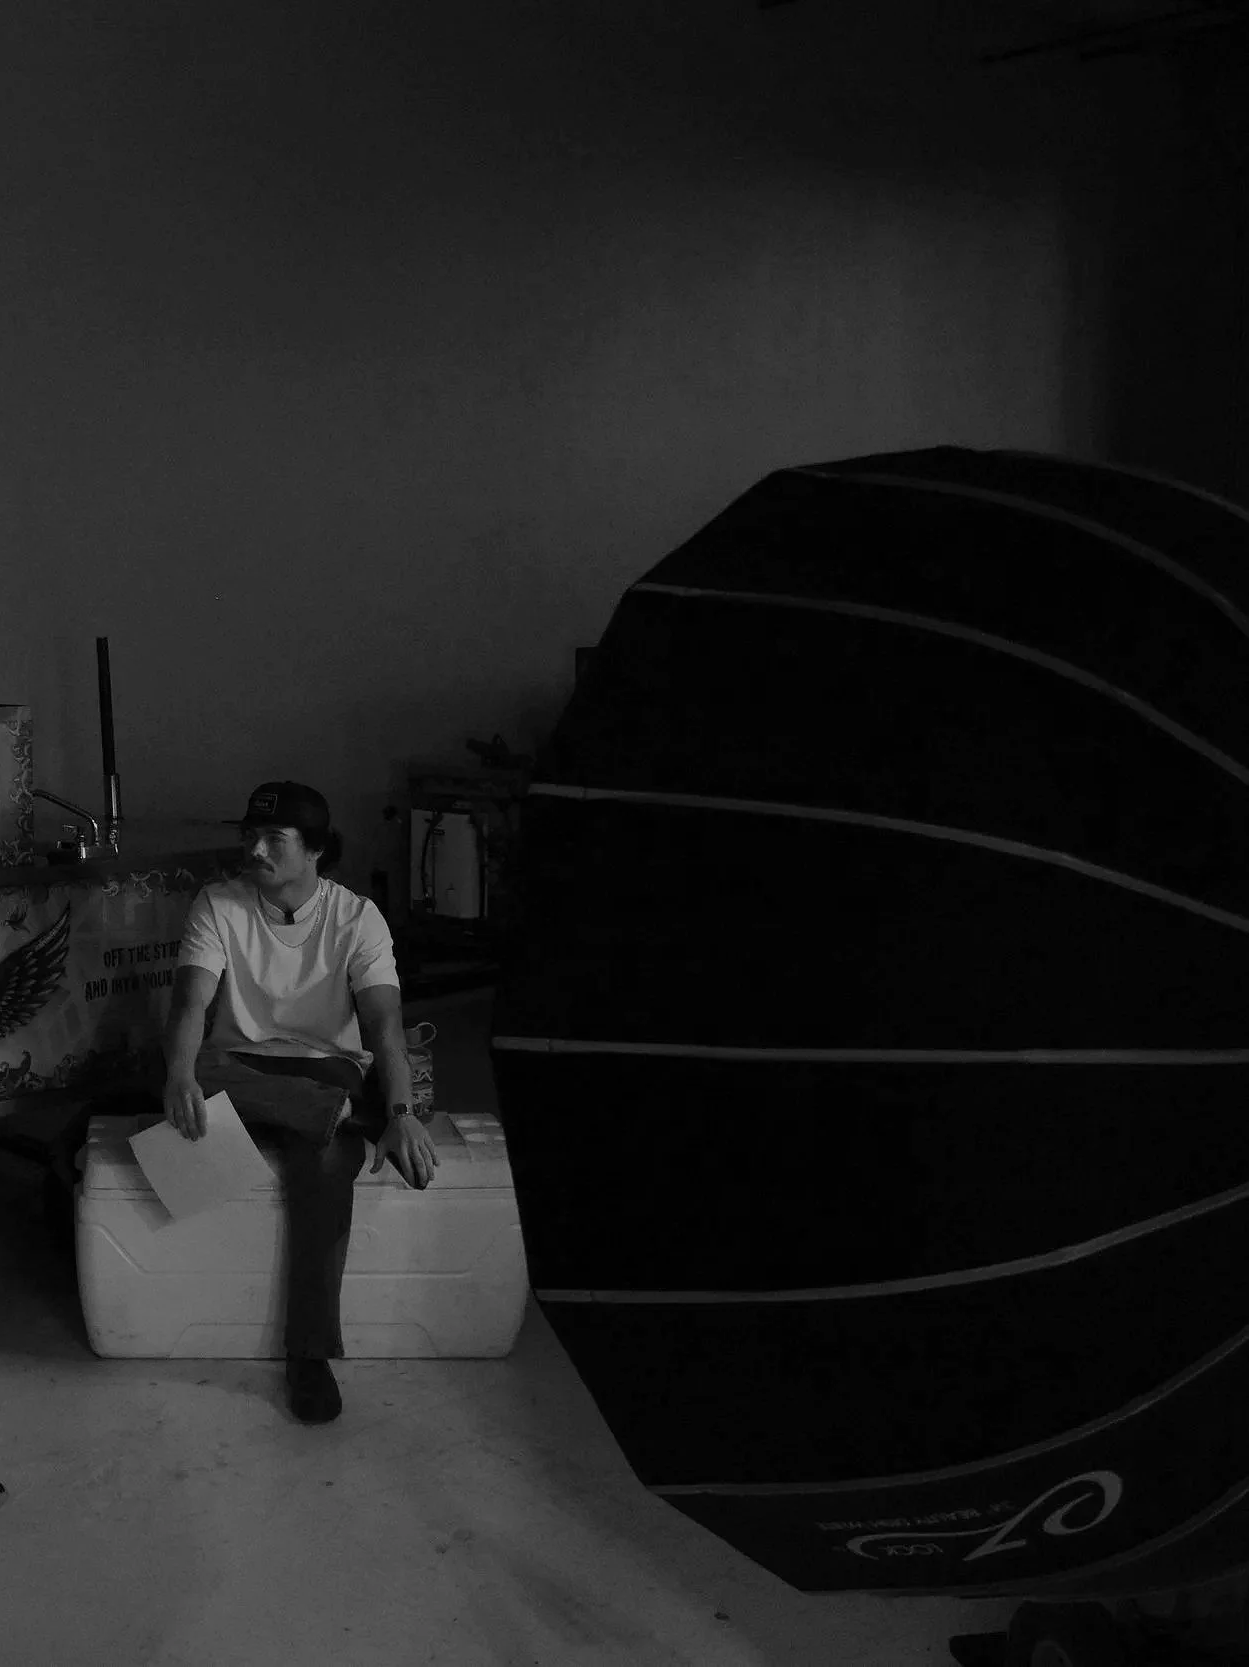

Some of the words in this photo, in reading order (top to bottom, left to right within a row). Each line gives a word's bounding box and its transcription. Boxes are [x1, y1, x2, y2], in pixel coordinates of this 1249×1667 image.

[103, 947, 124, 967] OFF
[128, 944, 151, 964] THE
[85, 977, 108, 1002] AND
